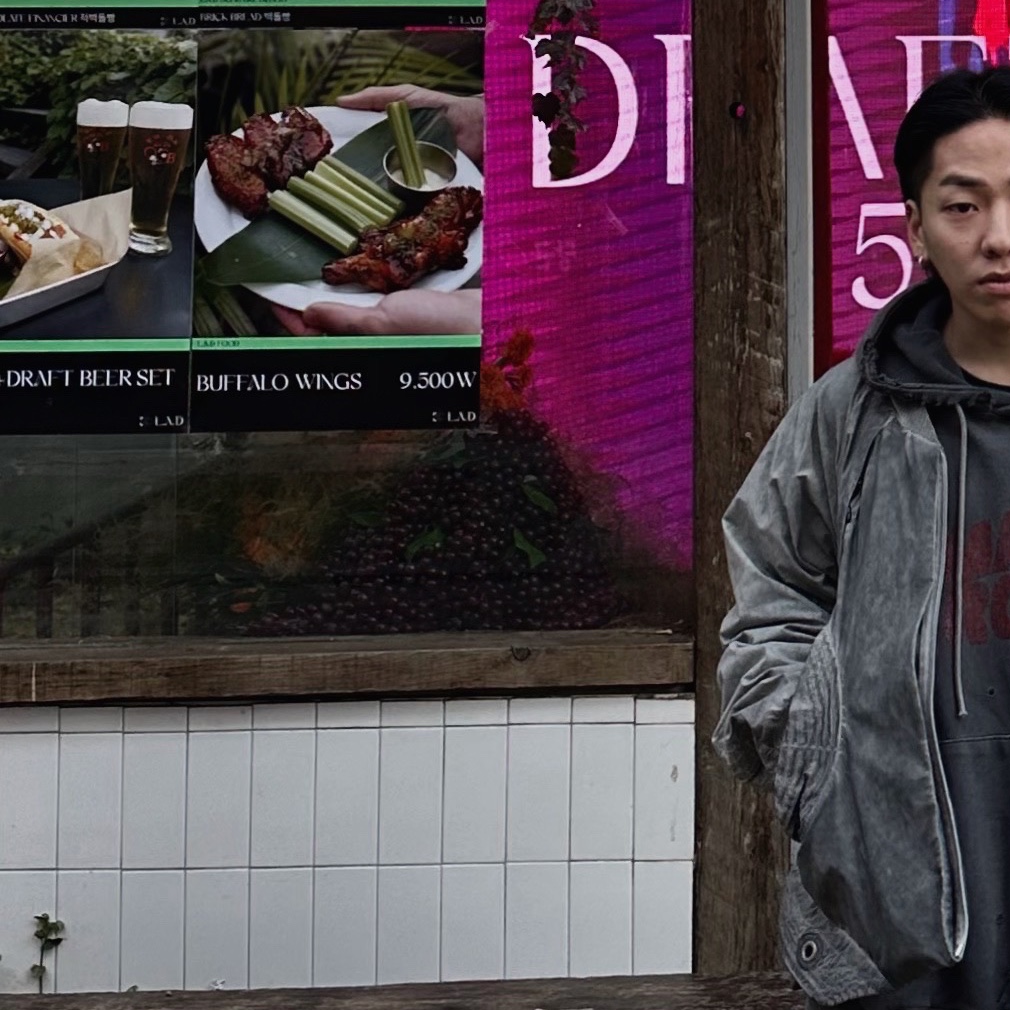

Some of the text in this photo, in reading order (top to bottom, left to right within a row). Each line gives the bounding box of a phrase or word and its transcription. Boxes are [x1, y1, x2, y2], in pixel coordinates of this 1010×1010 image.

[172, 17, 196, 25] LAD
[460, 16, 483, 25] LAD
[80, 369, 132, 387] BEER
[136, 368, 176, 387] SET
[196, 374, 289, 392] BUFFALO
[295, 372, 362, 391] WINGS
[154, 415, 184, 426] LAD
[447, 411, 477, 422] LAD
